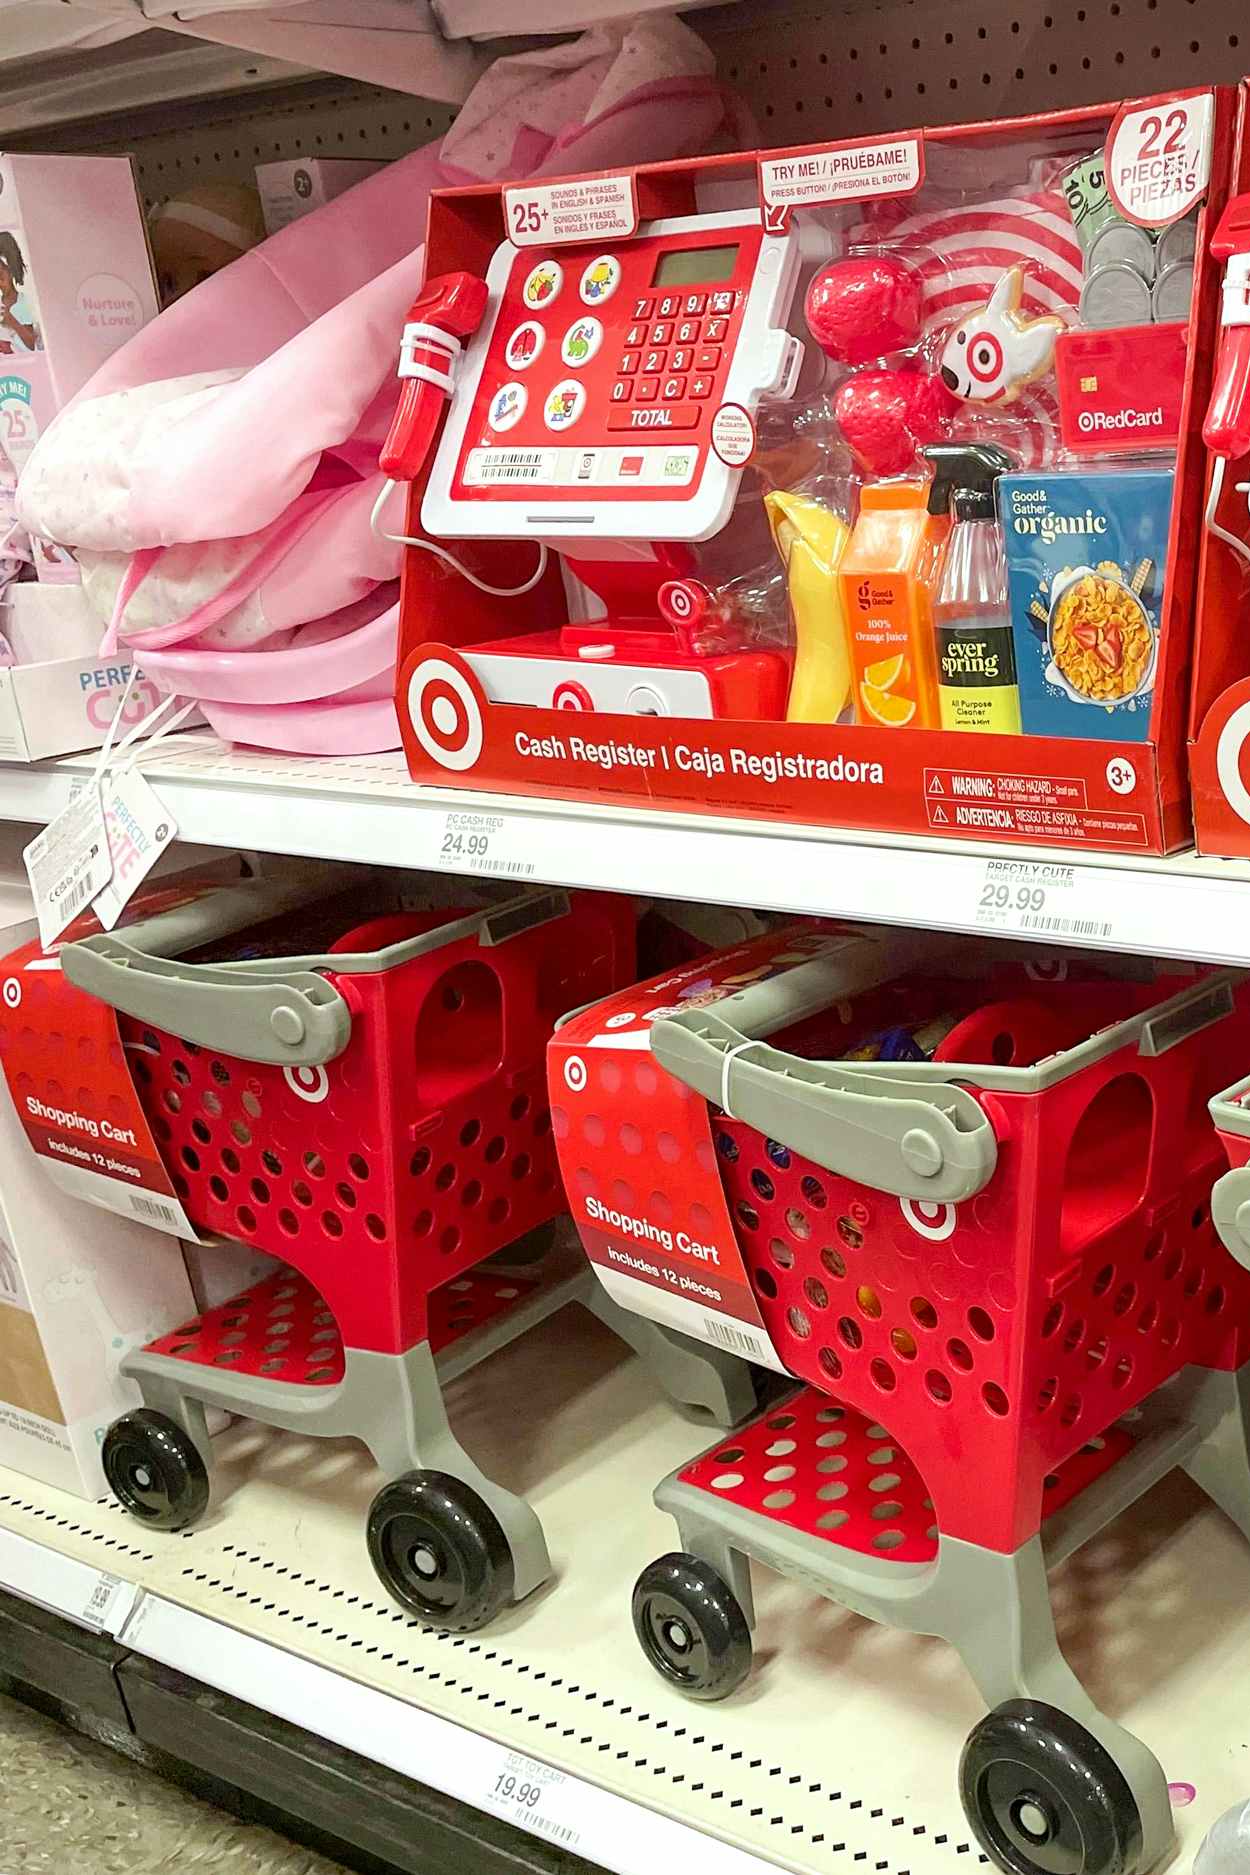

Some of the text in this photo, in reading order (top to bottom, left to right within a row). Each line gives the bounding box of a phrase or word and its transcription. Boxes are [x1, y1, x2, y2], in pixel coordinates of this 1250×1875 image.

[1137, 110, 1188, 160] 22
[772, 149, 907, 180] TRY ME! ¡PRUÉBAME!
[550, 190, 577, 200] SOUNDS
[585, 185, 617, 195] PHRASES
[771, 189, 796, 198] PRESS
[797, 184, 827, 195] BUTTON!
[872, 177, 880, 186] EL
[1065, 180, 1084, 210] 10
[1130, 174, 1196, 205] PIEZAS
[552, 201, 558, 209] IN
[560, 198, 588, 209] ENGLISH
[595, 194, 625, 205] SPANISH
[513, 202, 549, 233] 25+
[589, 210, 616, 220] FRASES
[554, 226, 563, 234] EN
[631, 409, 673, 425] TOTAL
[1094, 407, 1163, 431] RedCard
[1013, 503, 1047, 515] Gather
[1014, 509, 1107, 544] organic
[867, 619, 891, 629] 100%
[855, 632, 908, 643] Orange Juice
[948, 643, 987, 657] ever
[942, 654, 999, 677] spring
[957, 708, 985, 716] Cleaner
[961, 700, 992, 709] Purpose
[515, 731, 885, 785] Cash Register Caja Registradora
[952, 776, 1052, 797] WARNING: CHOKING HAZARD
[1111, 766, 1132, 786] 3+
[460, 815, 485, 826] CASH
[956, 807, 1015, 828] ADVERTENCIA:
[1015, 809, 1041, 823] RIESGO
[1042, 812, 1051, 824] DE
[441, 832, 489, 856] 24.99
[1041, 866, 1075, 880] CUTE
[979, 883, 1045, 912] 29.99
[26, 1095, 138, 1147] Shopping Cart
[47, 1137, 142, 1179] includes 12 pieces
[585, 1196, 720, 1266] Shopping Cart
[608, 1245, 723, 1303] includes 12 pieces
[494, 1772, 541, 1807] 19.99
